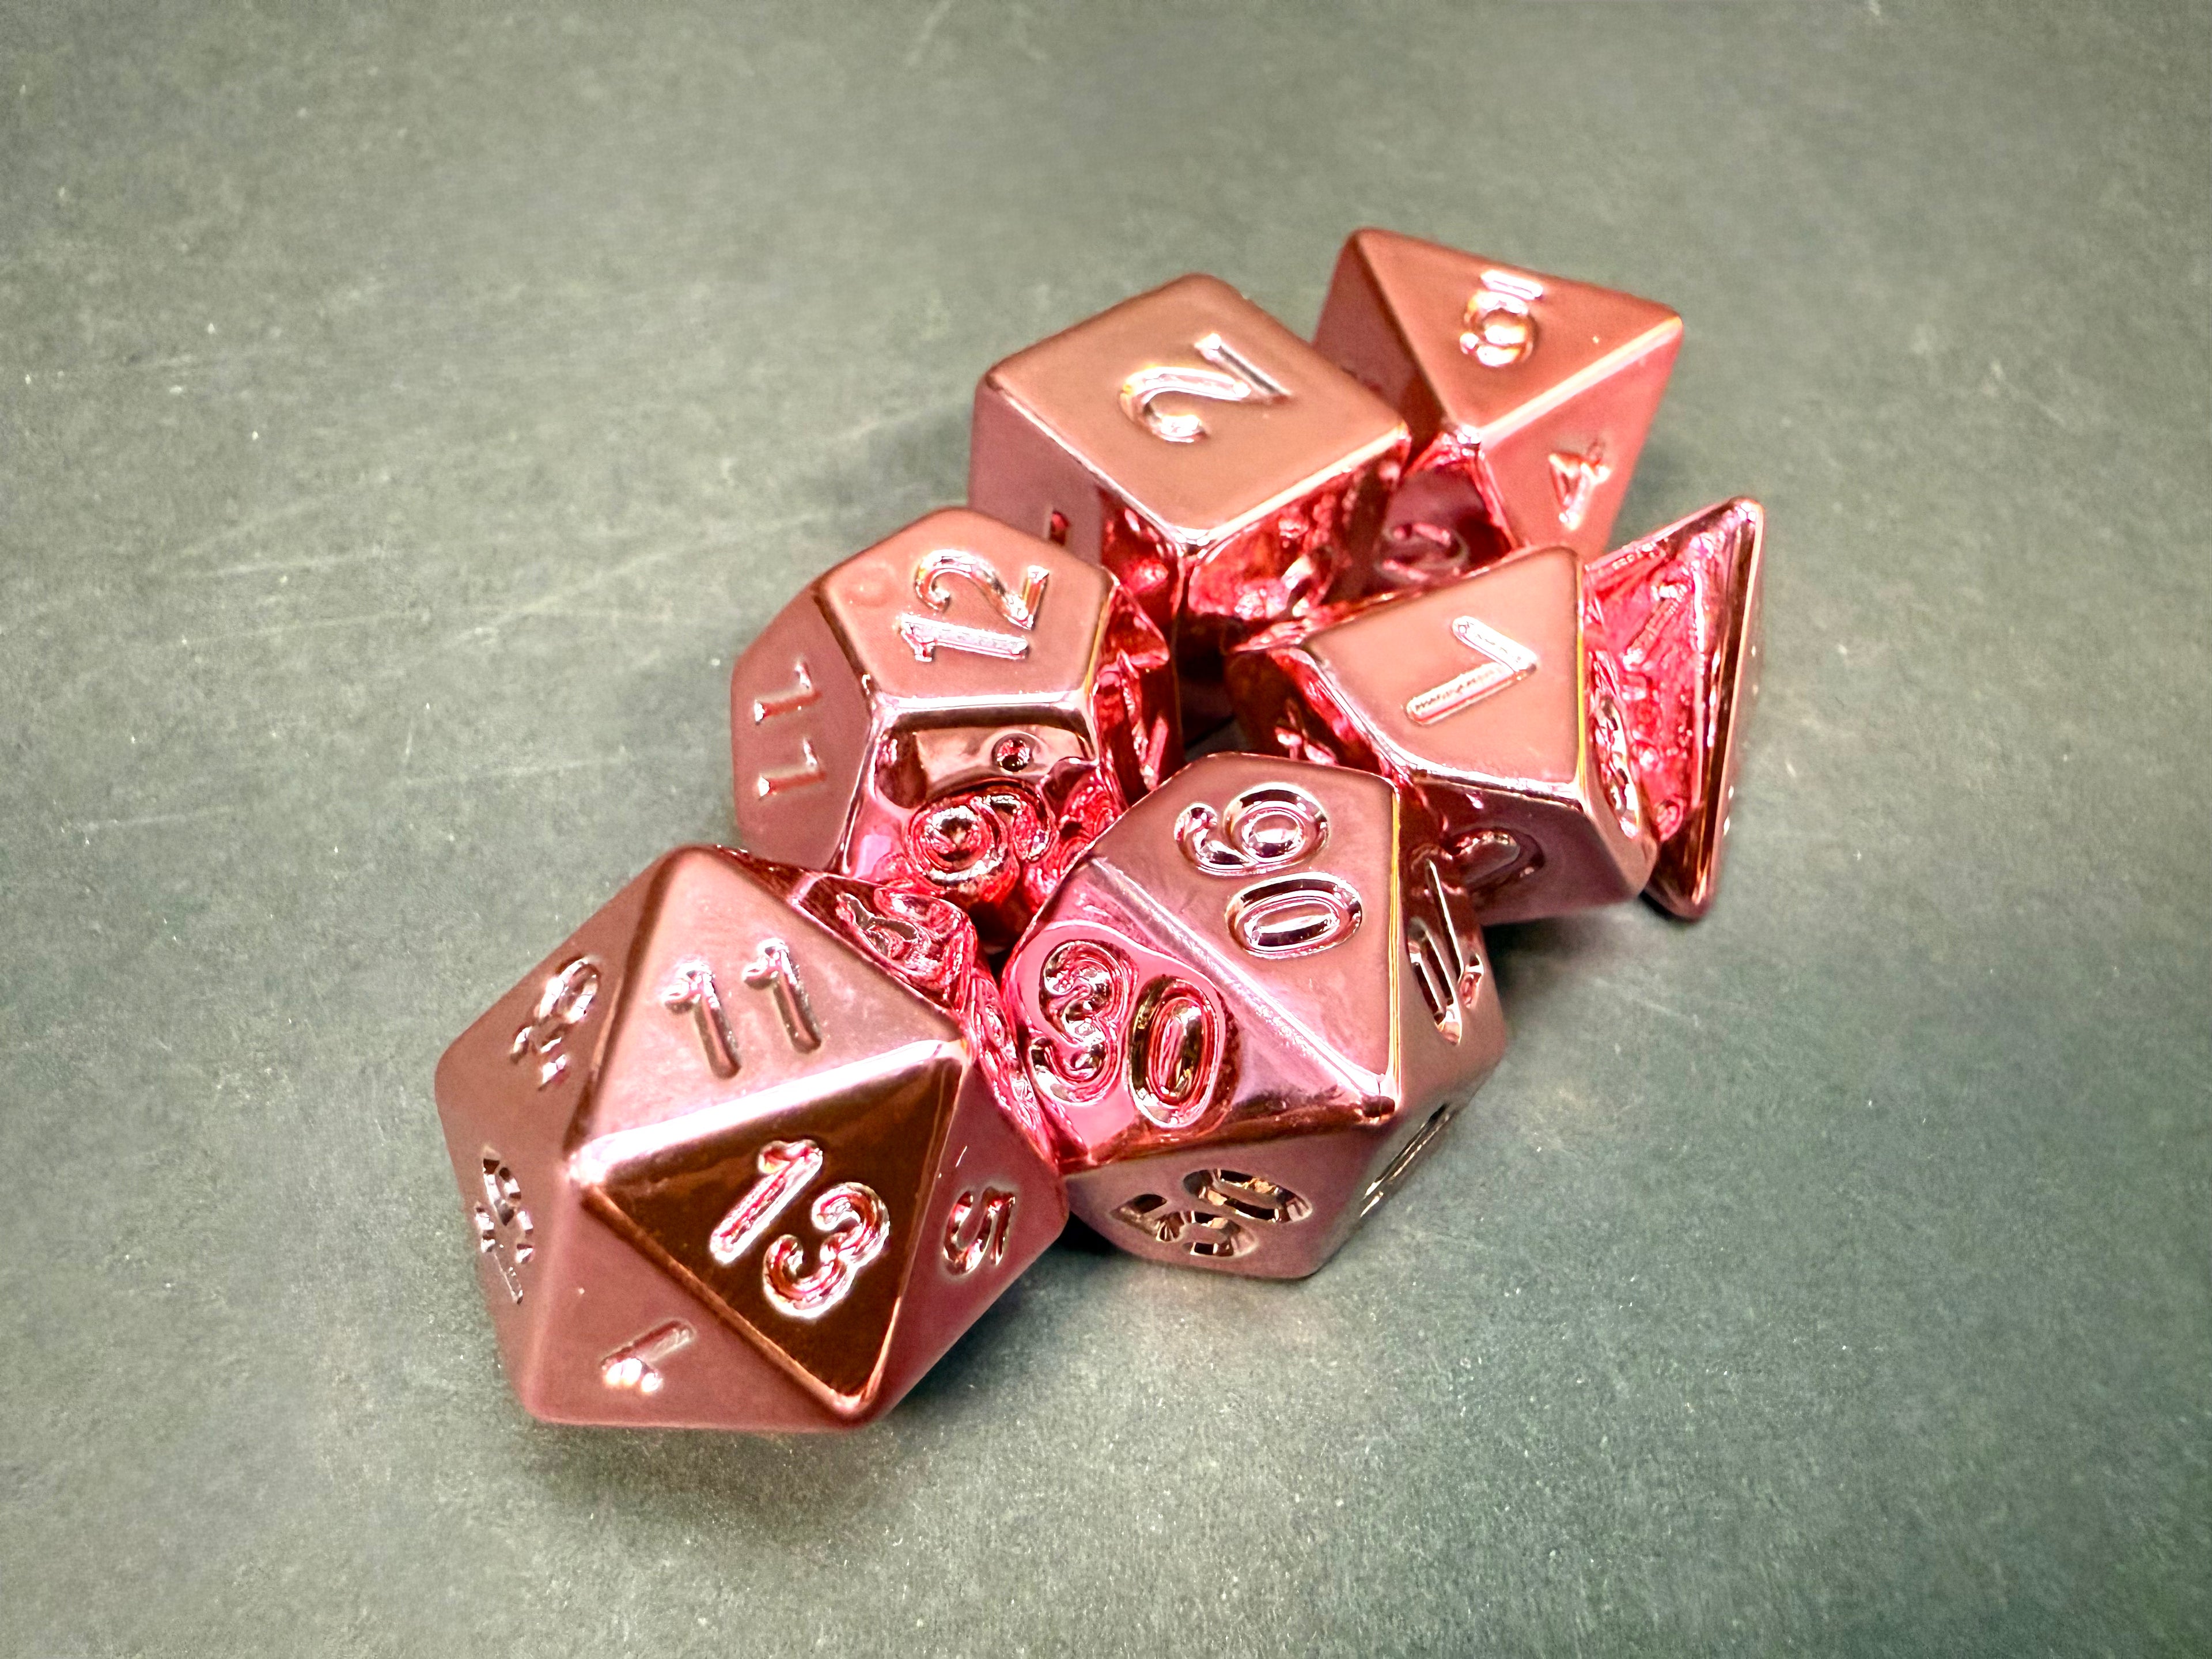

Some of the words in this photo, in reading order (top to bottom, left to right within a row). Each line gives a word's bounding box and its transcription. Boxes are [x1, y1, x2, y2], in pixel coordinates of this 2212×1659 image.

[1115, 331, 1290, 444] 2
[1547, 439, 1612, 531] 4
[896, 547, 1051, 662] 12
[1403, 613, 1539, 728] 7
[1173, 781, 1363, 959] 90
[659, 937, 823, 1079] 11
[1030, 938, 1229, 1130] 30
[708, 1138, 891, 1319] 13
[943, 1184, 1017, 1277] 5
[600, 1319, 695, 1395] 1
